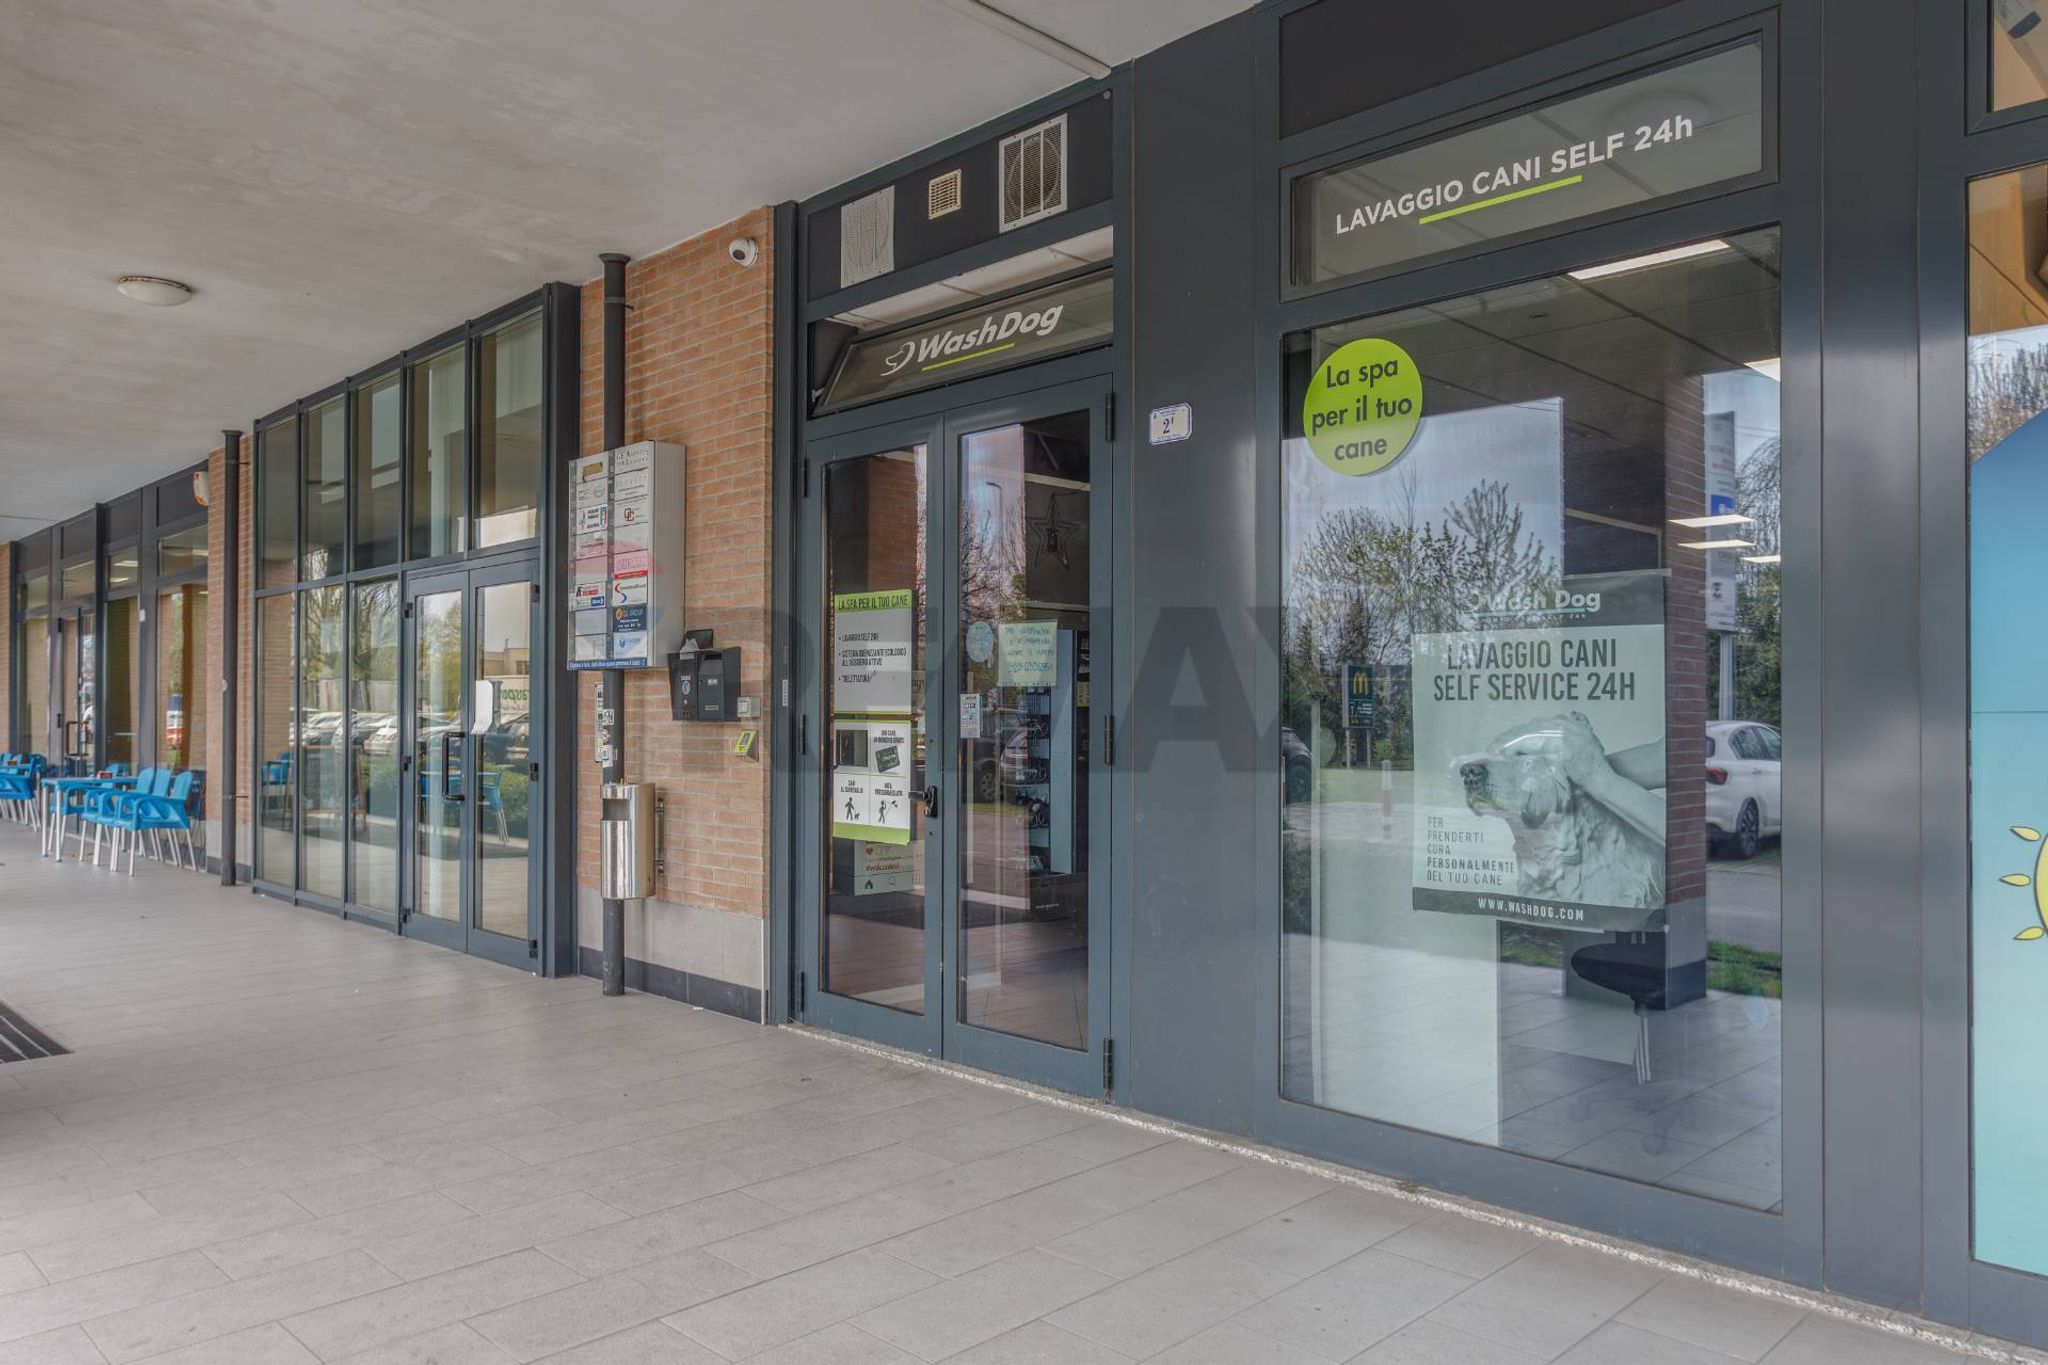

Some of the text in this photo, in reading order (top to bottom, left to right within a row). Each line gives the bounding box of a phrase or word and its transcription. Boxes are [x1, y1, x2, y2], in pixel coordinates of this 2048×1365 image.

[1336, 116, 1693, 236] LAVAGGIO CANI SELF 24h
[917, 304, 1064, 364] WashDog
[1326, 359, 1399, 389] La spa
[1312, 396, 1413, 435] per il tuo
[1335, 438, 1388, 462] cane
[1555, 590, 1600, 612] Dog
[1447, 638, 1616, 669] LAVAGGIO CANI
[1434, 672, 1635, 701] SELF SERVICE 24H
[1427, 816, 1443, 828] PER
[1427, 830, 1484, 843] PRENDERTI
[1427, 844, 1451, 854] CURA
[1427, 857, 1515, 874] PERSONALMENTE
[1427, 871, 1502, 886] DEL TUO CANE
[1478, 898, 1585, 921] WWW.WASHDOG.COM
